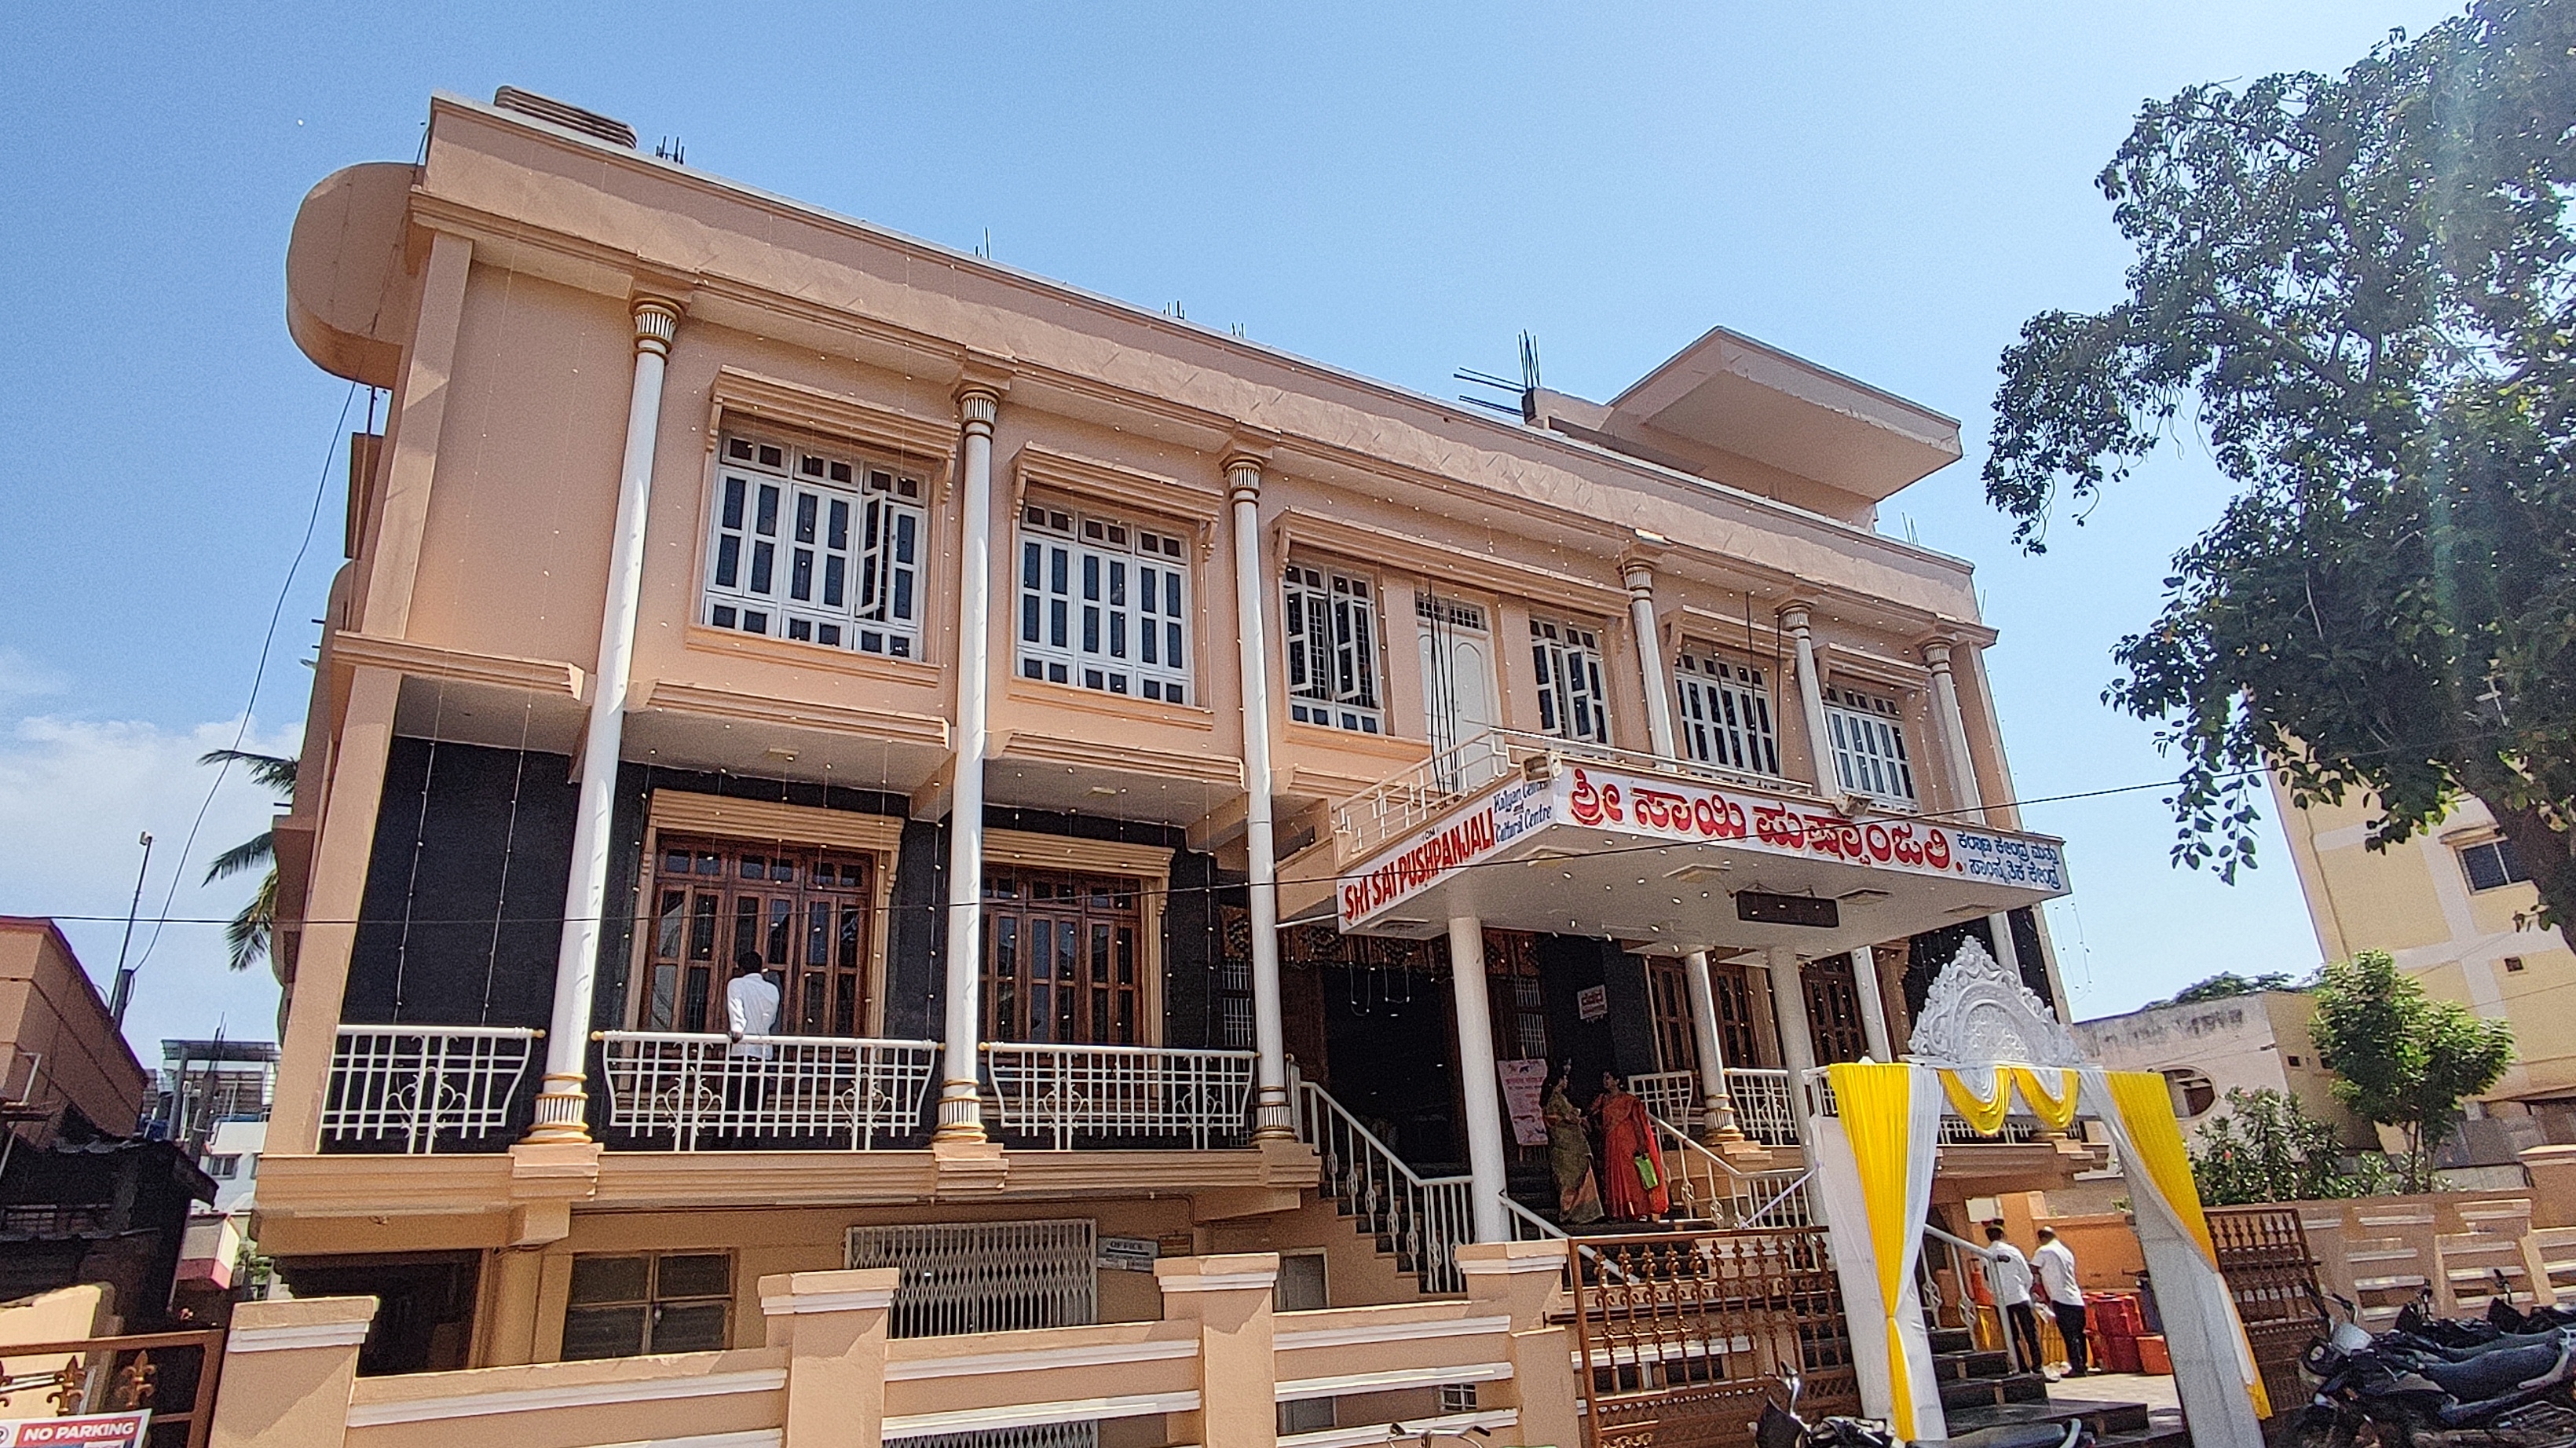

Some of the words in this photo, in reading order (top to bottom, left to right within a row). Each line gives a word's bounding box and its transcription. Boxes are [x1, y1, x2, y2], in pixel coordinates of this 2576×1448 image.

[1493, 788, 1522, 814] Kalyan
[1569, 767, 1624, 826] ಶ್ರೀ
[1630, 787, 1747, 840] ಸಾಯಿ
[1493, 814, 1524, 843] Cultural
[1524, 803, 1552, 830] Centre
[1345, 876, 1370, 921] SRI
[1372, 861, 1397, 906] SAI
[1398, 806, 1495, 894] PUSHPANJALI
[1994, 836, 2030, 862] ಕೇಂದ್ರ
[2031, 842, 2060, 865] ಮತ್ತು
[1110, 1241, 1143, 1251] OFFICE
[23, 1427, 53, 1443] NO
[55, 1421, 135, 1440] PARKING
